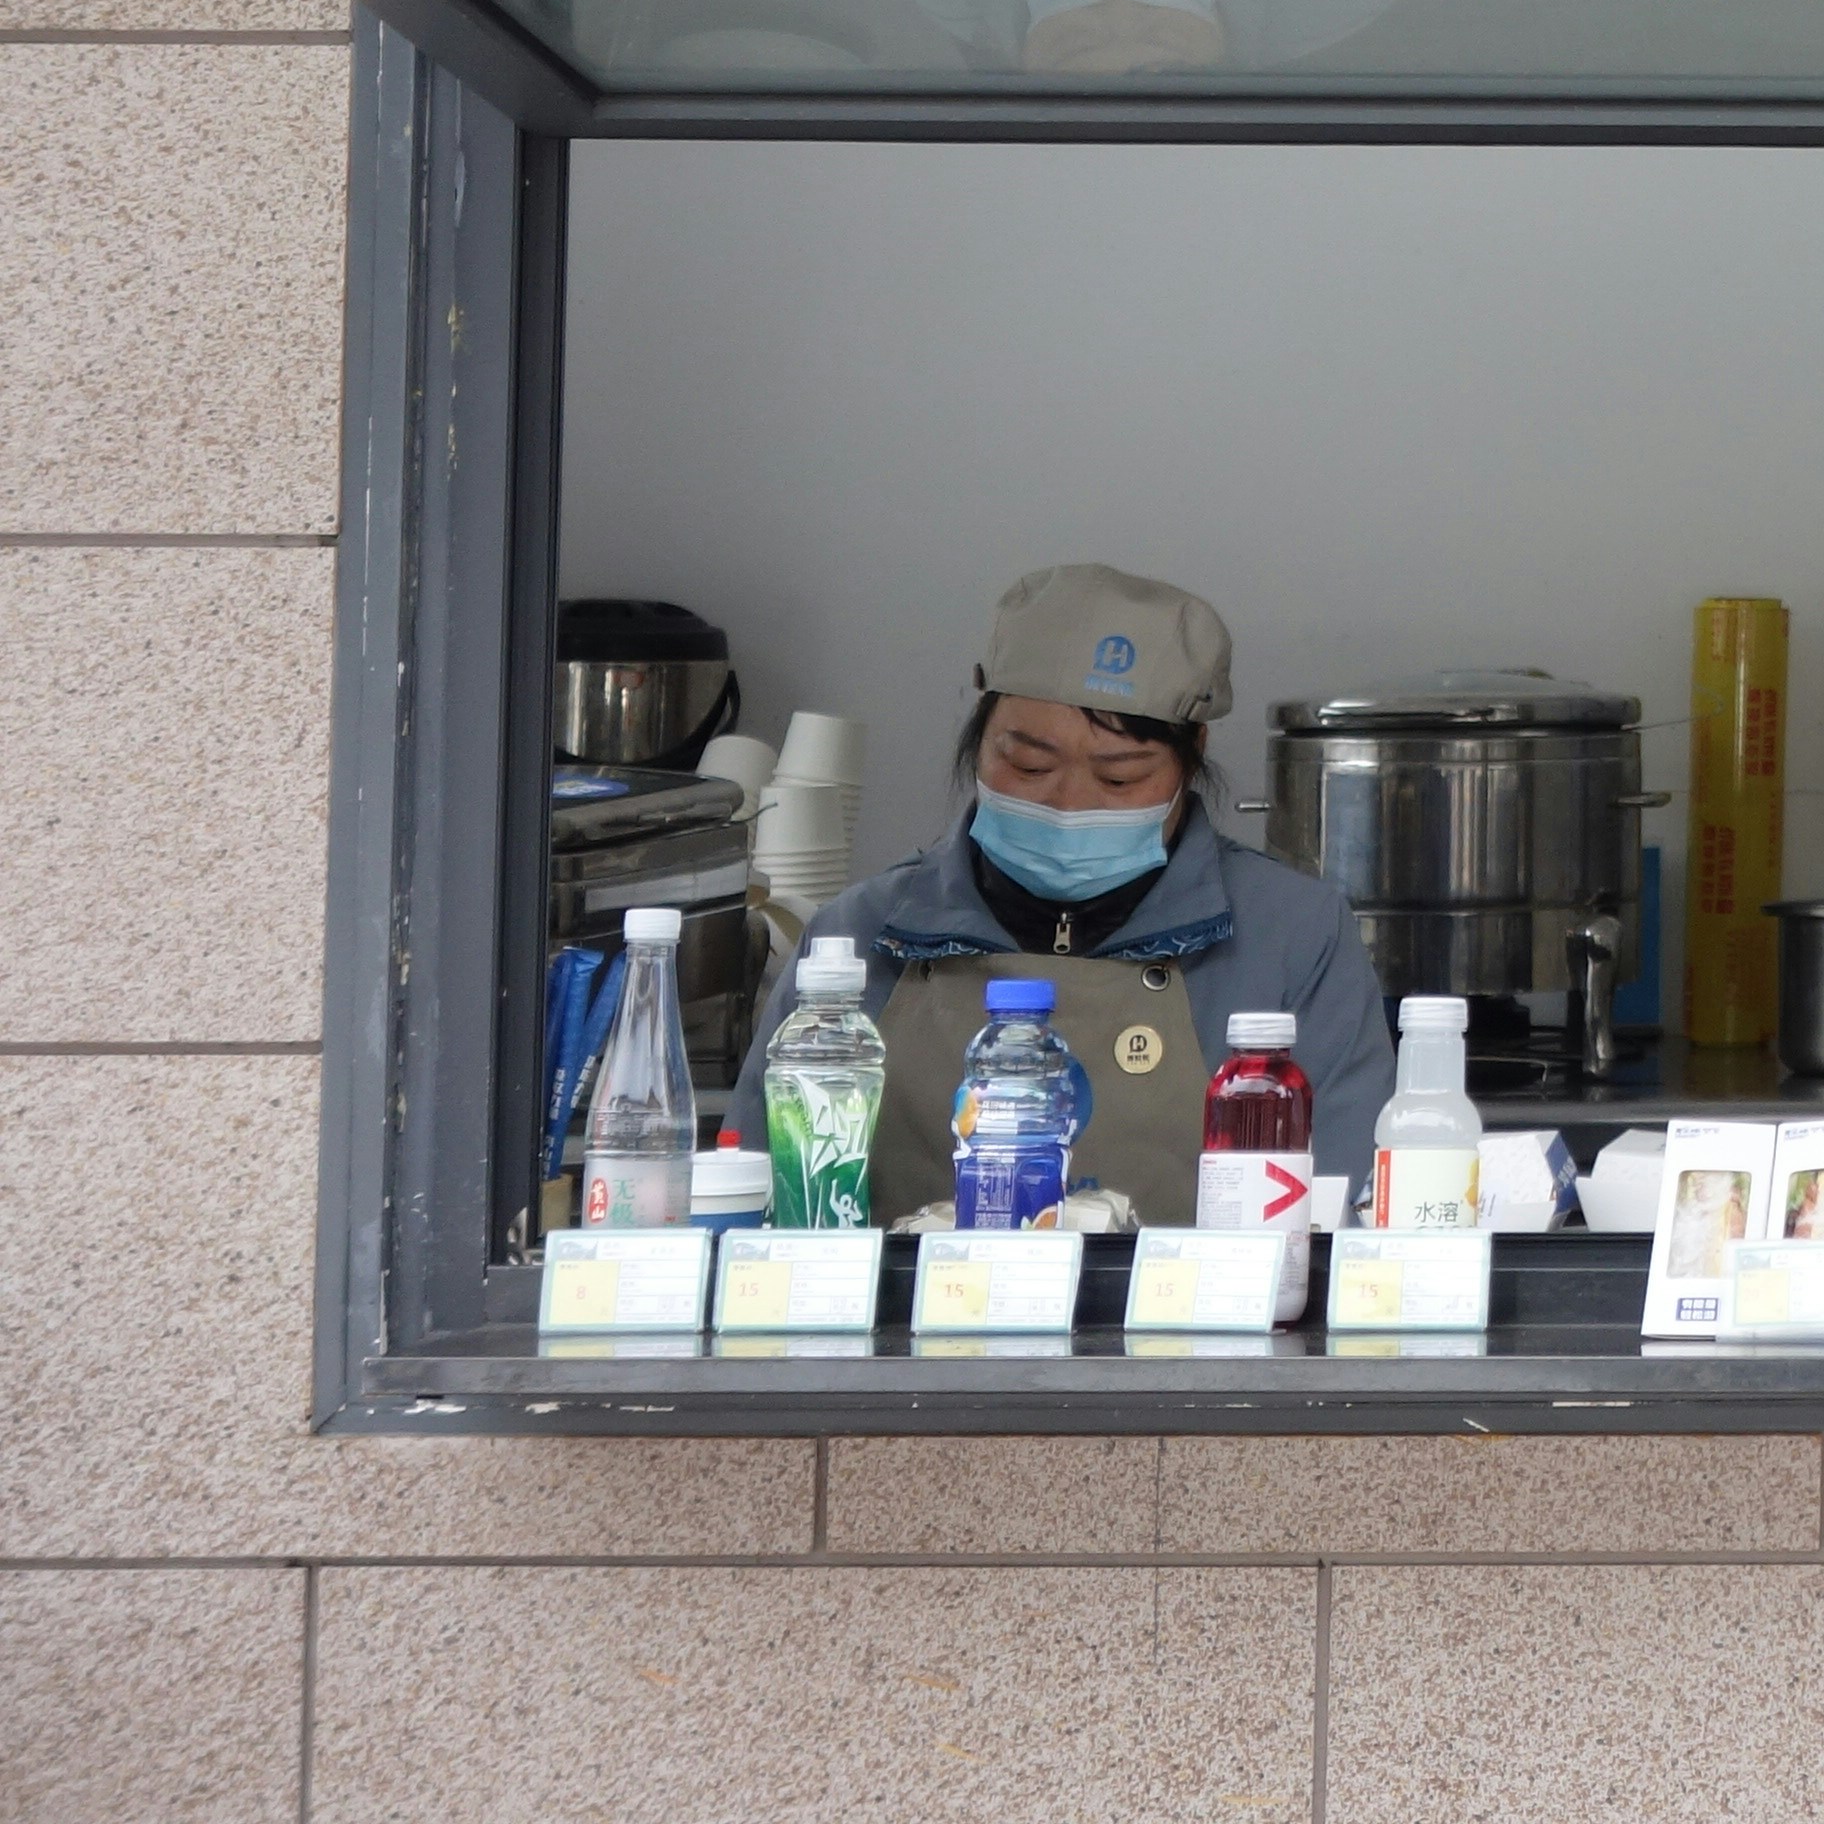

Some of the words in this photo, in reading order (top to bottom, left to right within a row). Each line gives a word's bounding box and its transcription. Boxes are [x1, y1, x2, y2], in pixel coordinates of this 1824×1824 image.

[1414, 1201, 1459, 1223] 水溶
[576, 1285, 587, 1300] 8
[736, 1280, 760, 1297] 15
[944, 1282, 966, 1298] 15
[1155, 1282, 1175, 1298] 15
[1359, 1283, 1379, 1299] 15
